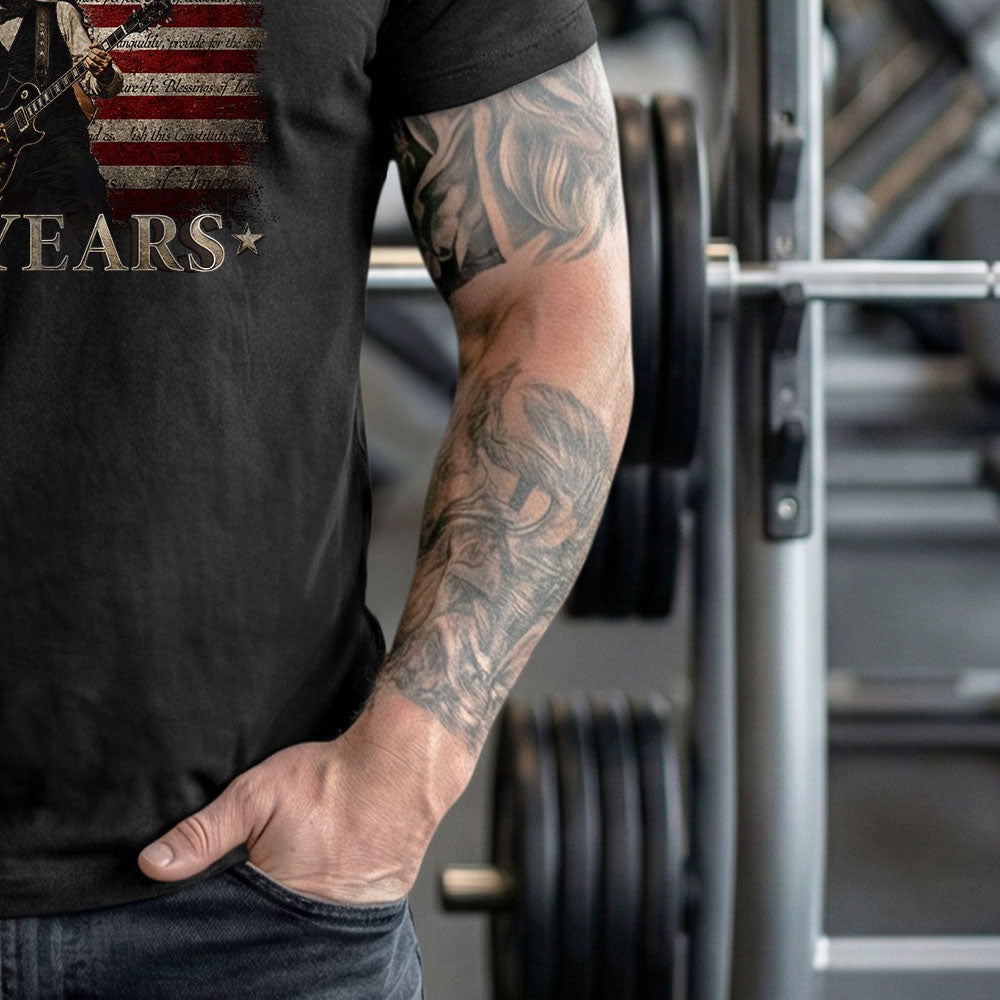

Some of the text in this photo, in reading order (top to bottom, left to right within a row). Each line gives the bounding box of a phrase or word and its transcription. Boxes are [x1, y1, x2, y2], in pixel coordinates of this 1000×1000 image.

[116, 34, 165, 52] anquility,
[141, 79, 159, 93] the
[163, 78, 214, 96] Blessings
[216, 78, 233, 96] of
[151, 126, 171, 141] this
